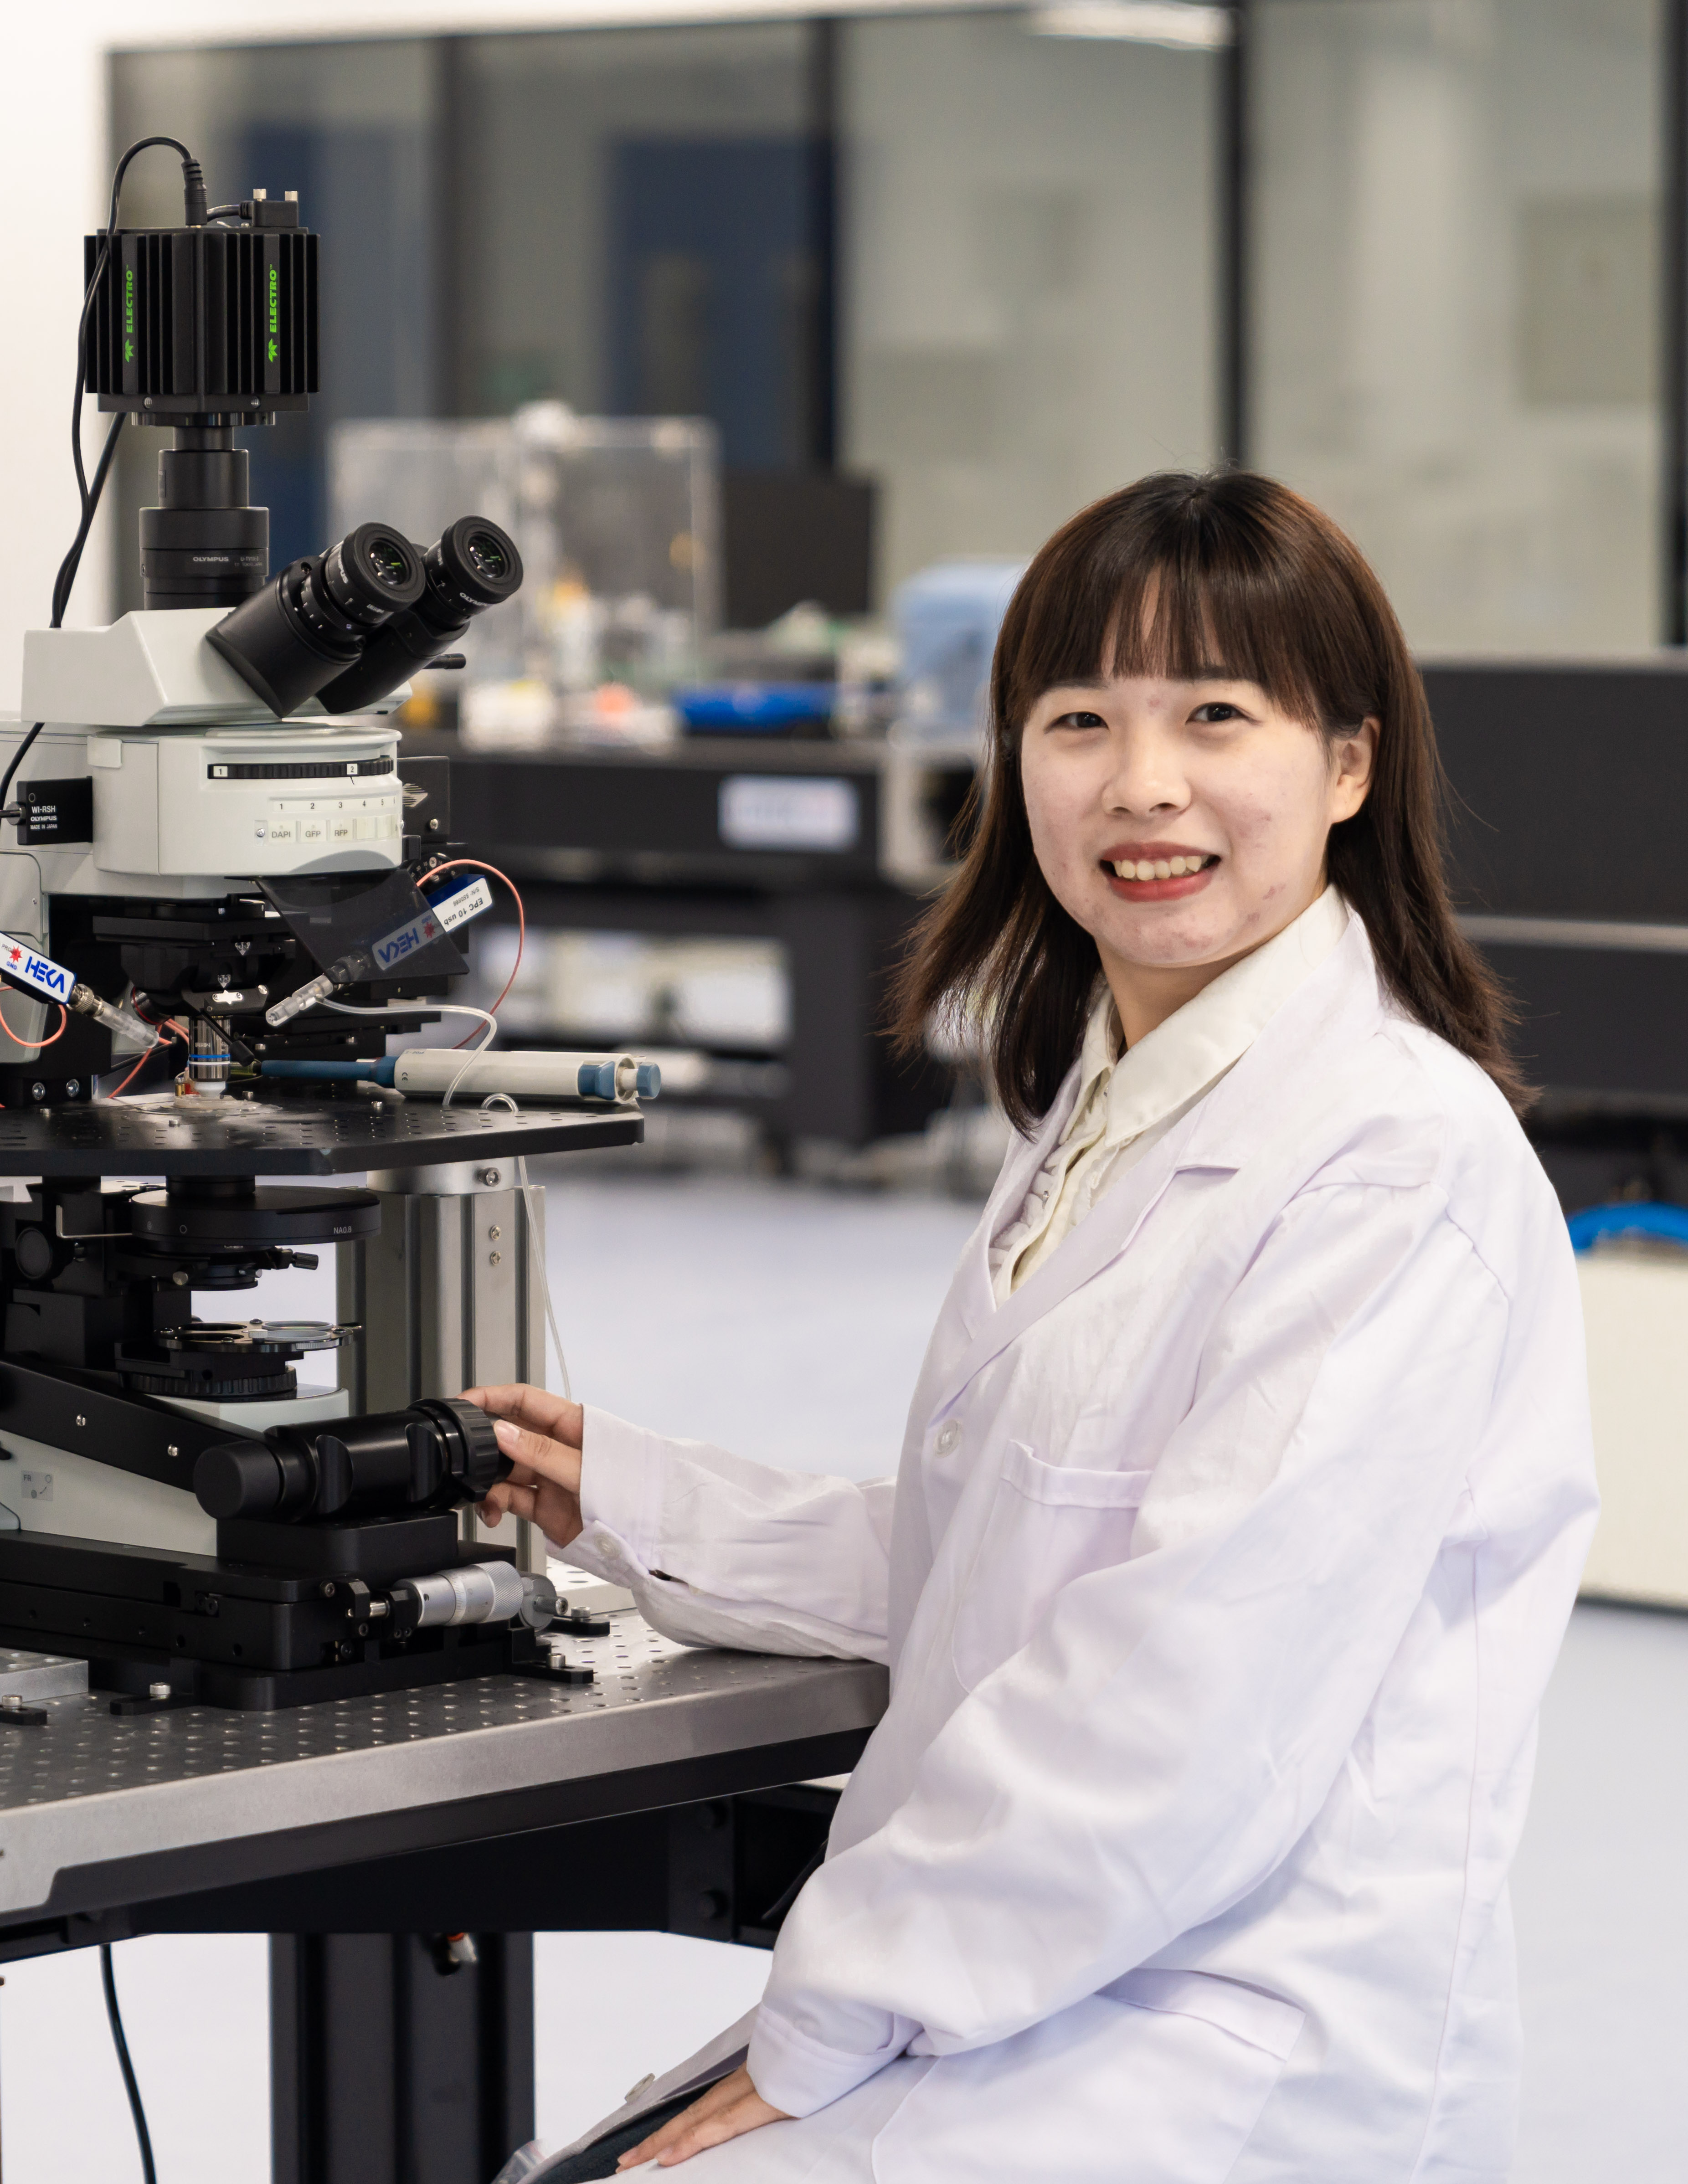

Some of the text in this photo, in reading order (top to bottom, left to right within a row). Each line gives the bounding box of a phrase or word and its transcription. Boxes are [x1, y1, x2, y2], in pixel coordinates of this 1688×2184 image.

[443, 897, 484, 925] EPC 10 usb
[377, 927, 420, 963] HEKA
[6, 961, 17, 970] GND
[25, 956, 64, 994] HEKA
[334, 1226, 352, 1234] NA0.8
